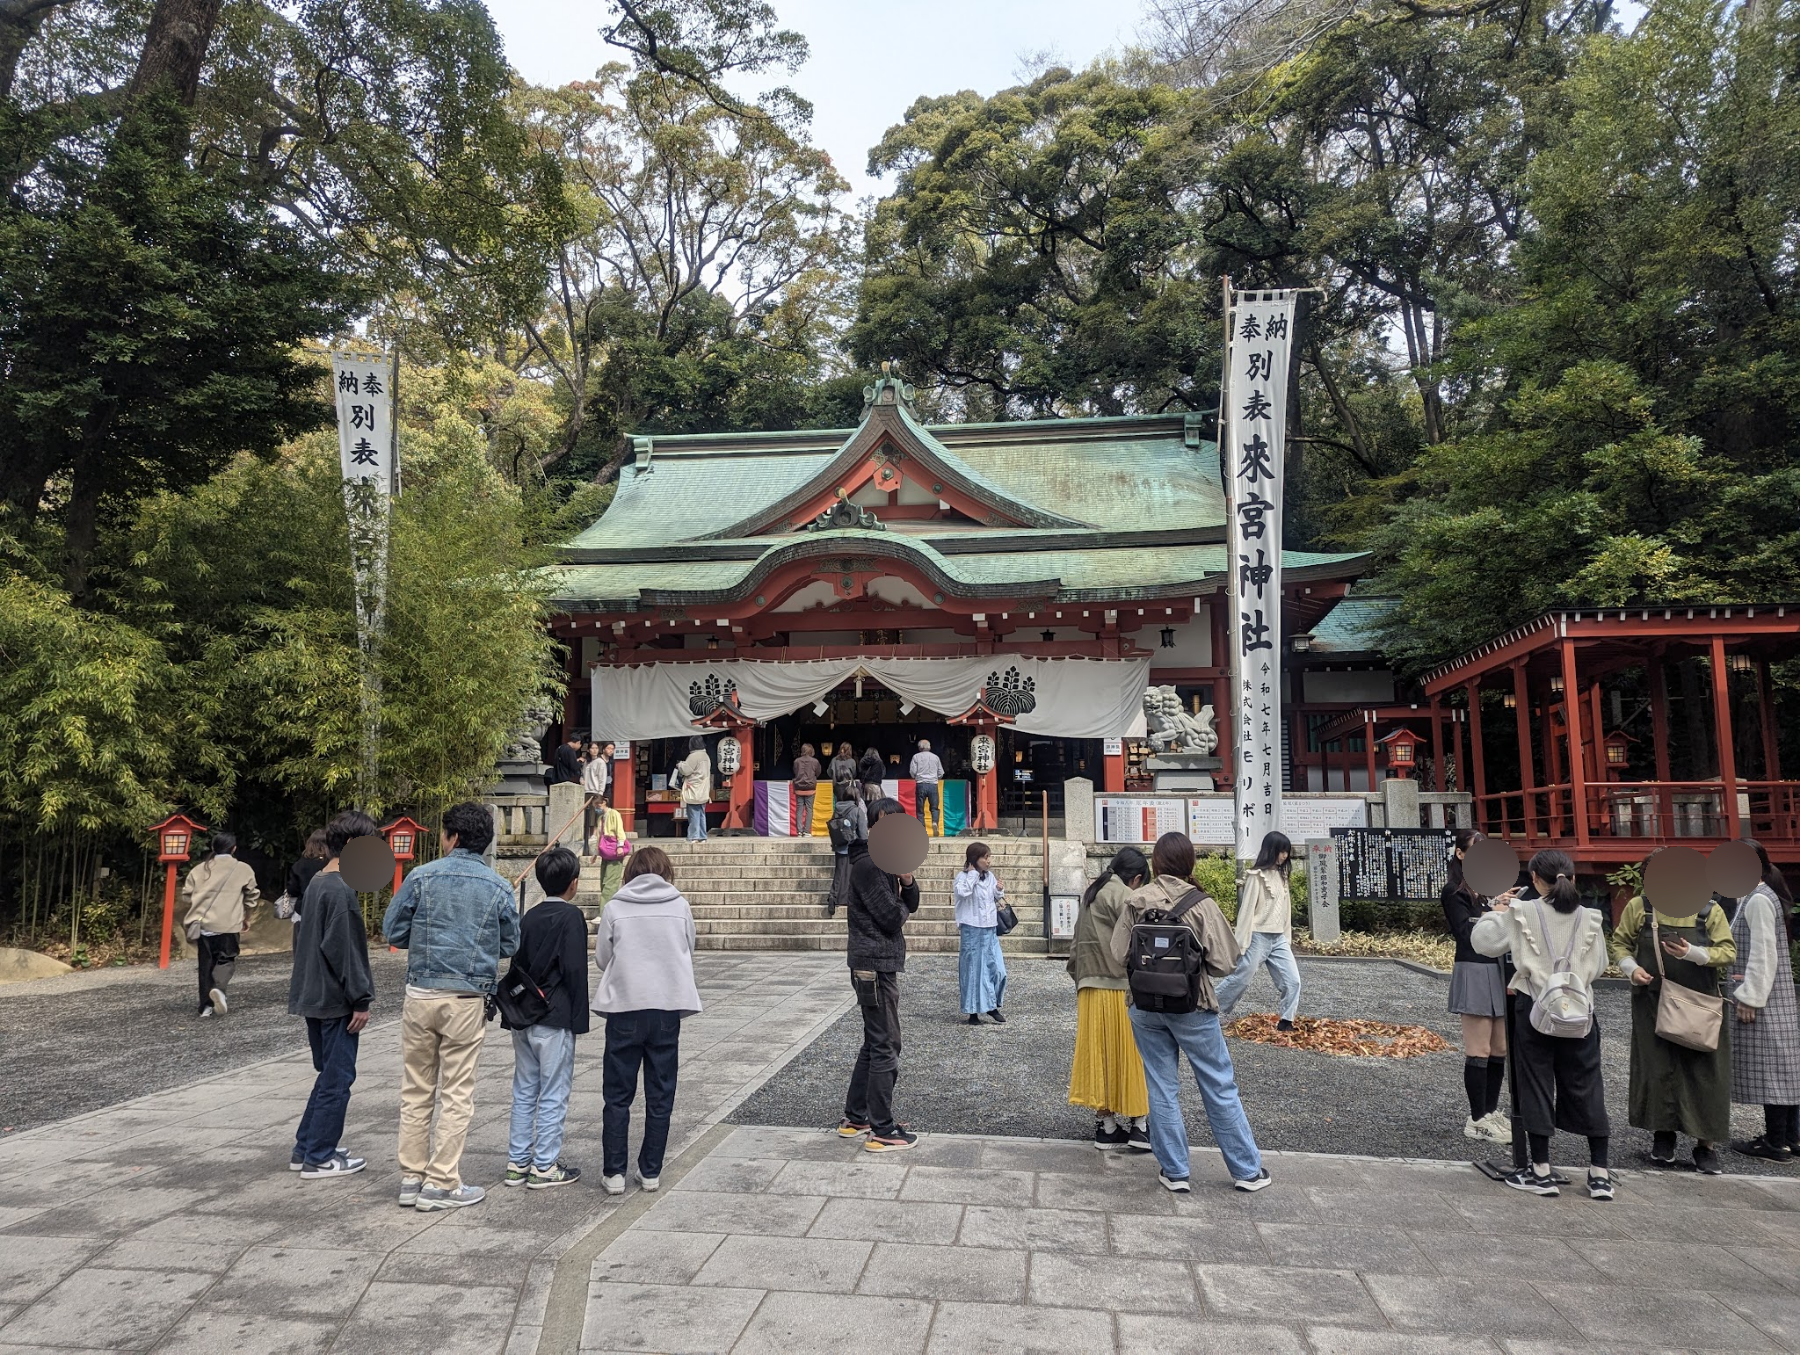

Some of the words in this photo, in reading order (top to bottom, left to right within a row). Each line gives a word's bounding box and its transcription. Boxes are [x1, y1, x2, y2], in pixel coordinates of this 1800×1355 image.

[1239, 312, 1288, 343] 奉納
[1260, 662, 1272, 816] 令和七年七月吉日
